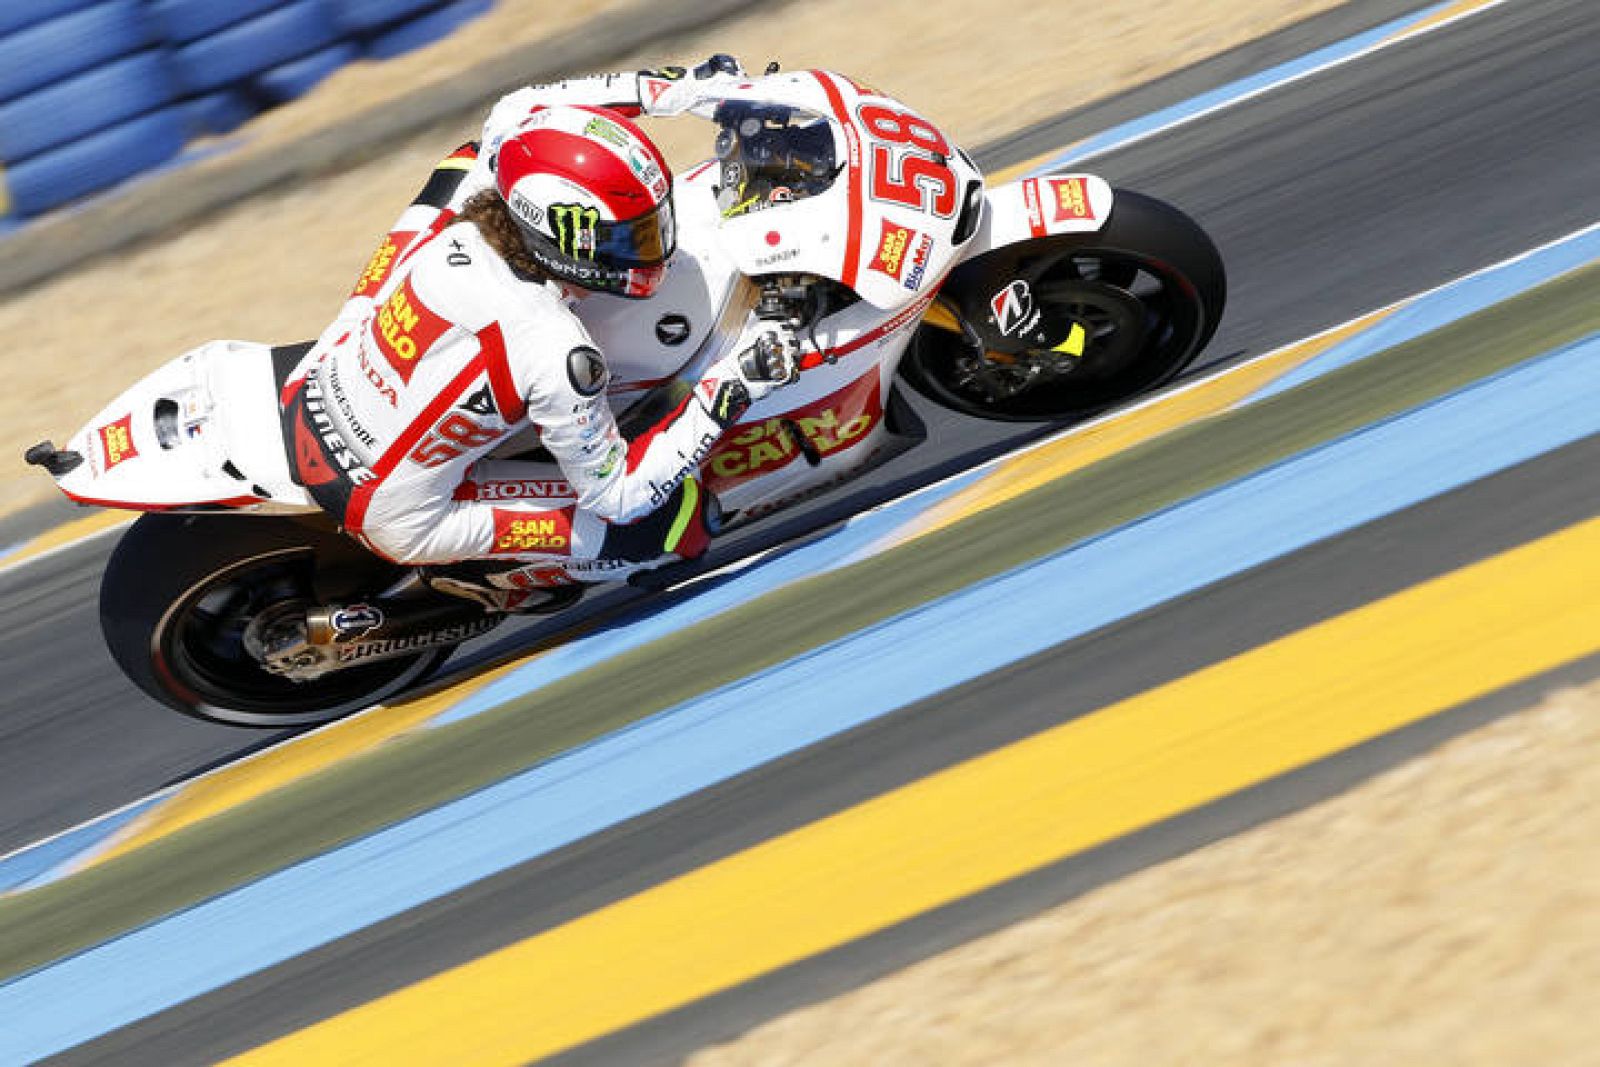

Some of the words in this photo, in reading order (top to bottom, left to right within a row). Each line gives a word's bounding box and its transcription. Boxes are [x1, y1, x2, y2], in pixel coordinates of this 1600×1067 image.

[856, 102, 959, 219] 58
[406, 410, 508, 470] 58
[477, 482, 574, 499] HOND
[510, 520, 556, 535] SAN
[499, 535, 567, 549] CARLO
